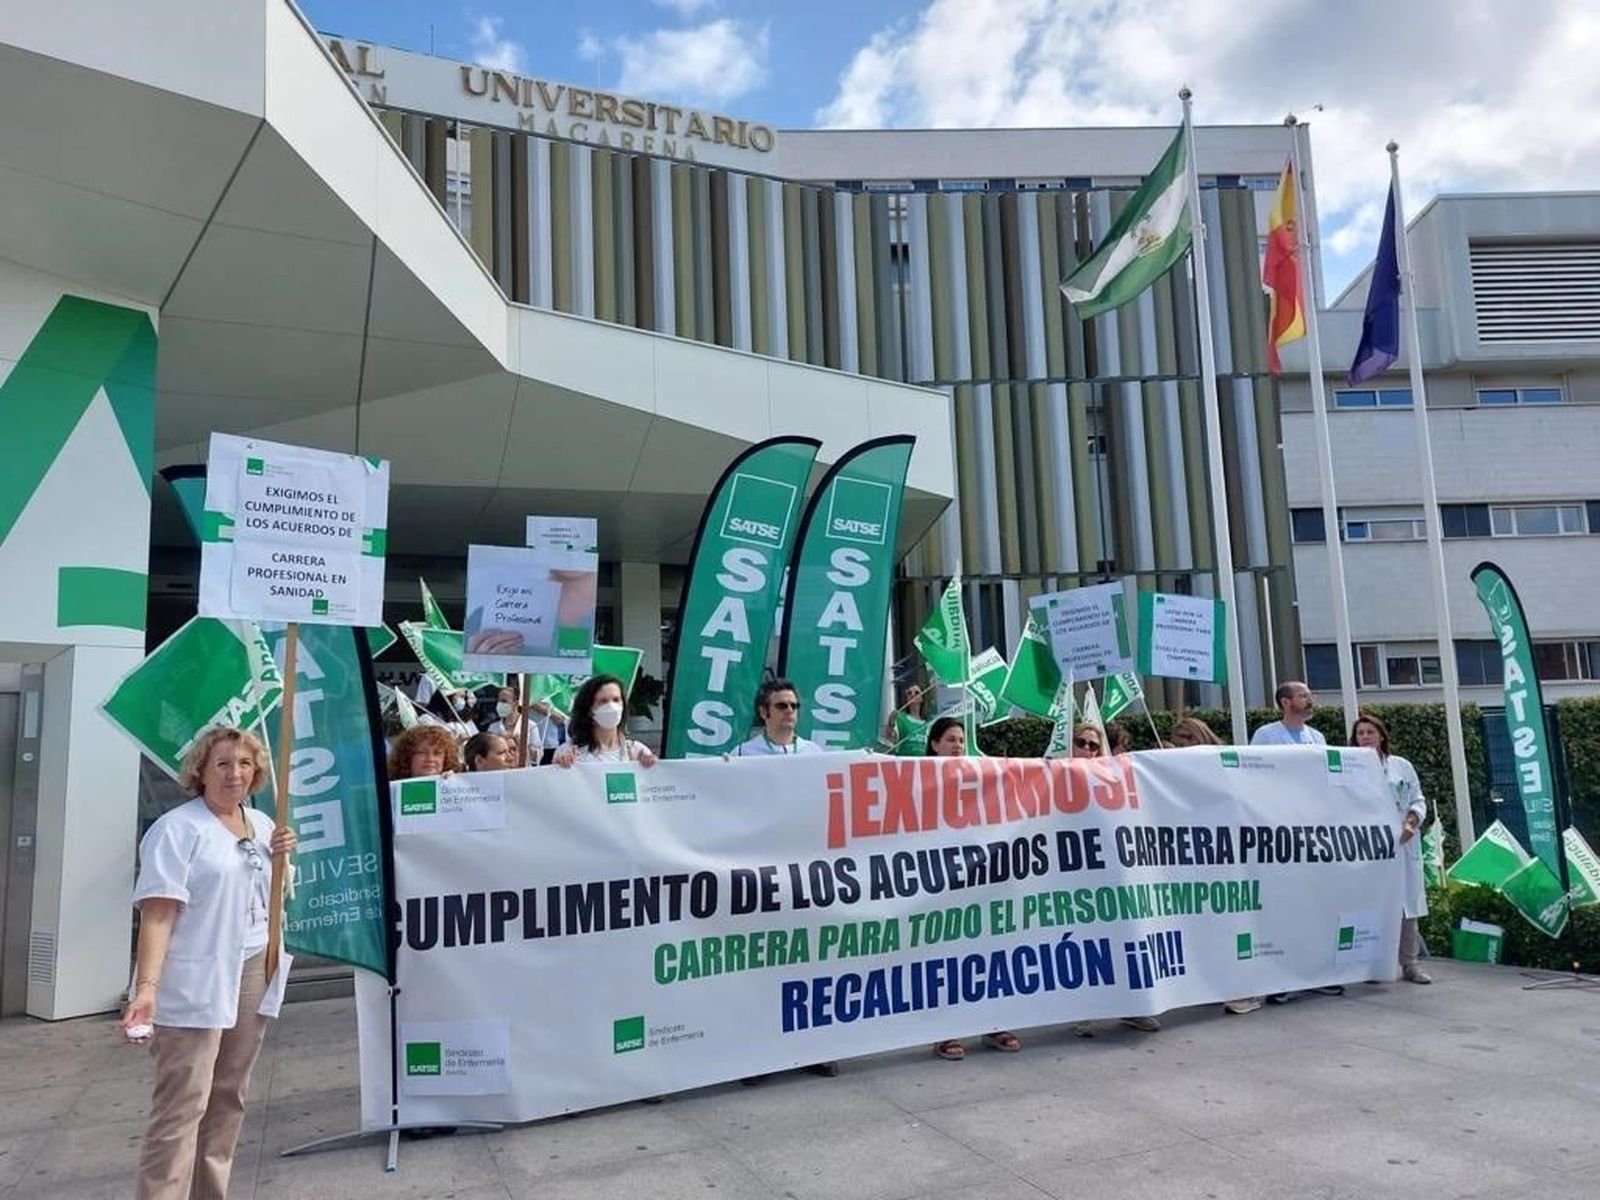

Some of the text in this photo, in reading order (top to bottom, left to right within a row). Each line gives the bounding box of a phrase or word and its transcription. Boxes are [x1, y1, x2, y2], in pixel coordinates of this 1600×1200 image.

[461, 66, 776, 154] UNIVERSITARIO
[517, 111, 696, 162] MACARENA
[265, 486, 338, 504] EXIGIMOS EL
[245, 501, 356, 522] CUMPLIMIENTO DE
[246, 517, 353, 538] LOS ACUERDOS DE
[729, 517, 780, 539] SATSE
[832, 518, 881, 536] SATSE
[271, 553, 325, 567] CARRERA
[247, 567, 346, 584] PROFESIONAL EN
[270, 585, 324, 598] SANIDAD
[686, 548, 768, 758] SATS
[403, 802, 435, 812] SATSE
[826, 756, 1140, 849] ¡EXIGIMOS!
[730, 865, 781, 915] DE
[788, 857, 861, 910] LOS
[870, 833, 1049, 901] ACUERDOS
[1056, 828, 1105, 872] DE
[1115, 825, 1235, 868] CARRERA
[1239, 825, 1396, 864] PROFESIONAL
[654, 879, 1262, 986] CARRERA PARA TODO EL PERSONAL TEMPORAL
[782, 931, 1186, 1033] RECALIFICACIÓN ¡¡YA!!
[409, 1064, 439, 1073] SATSE
